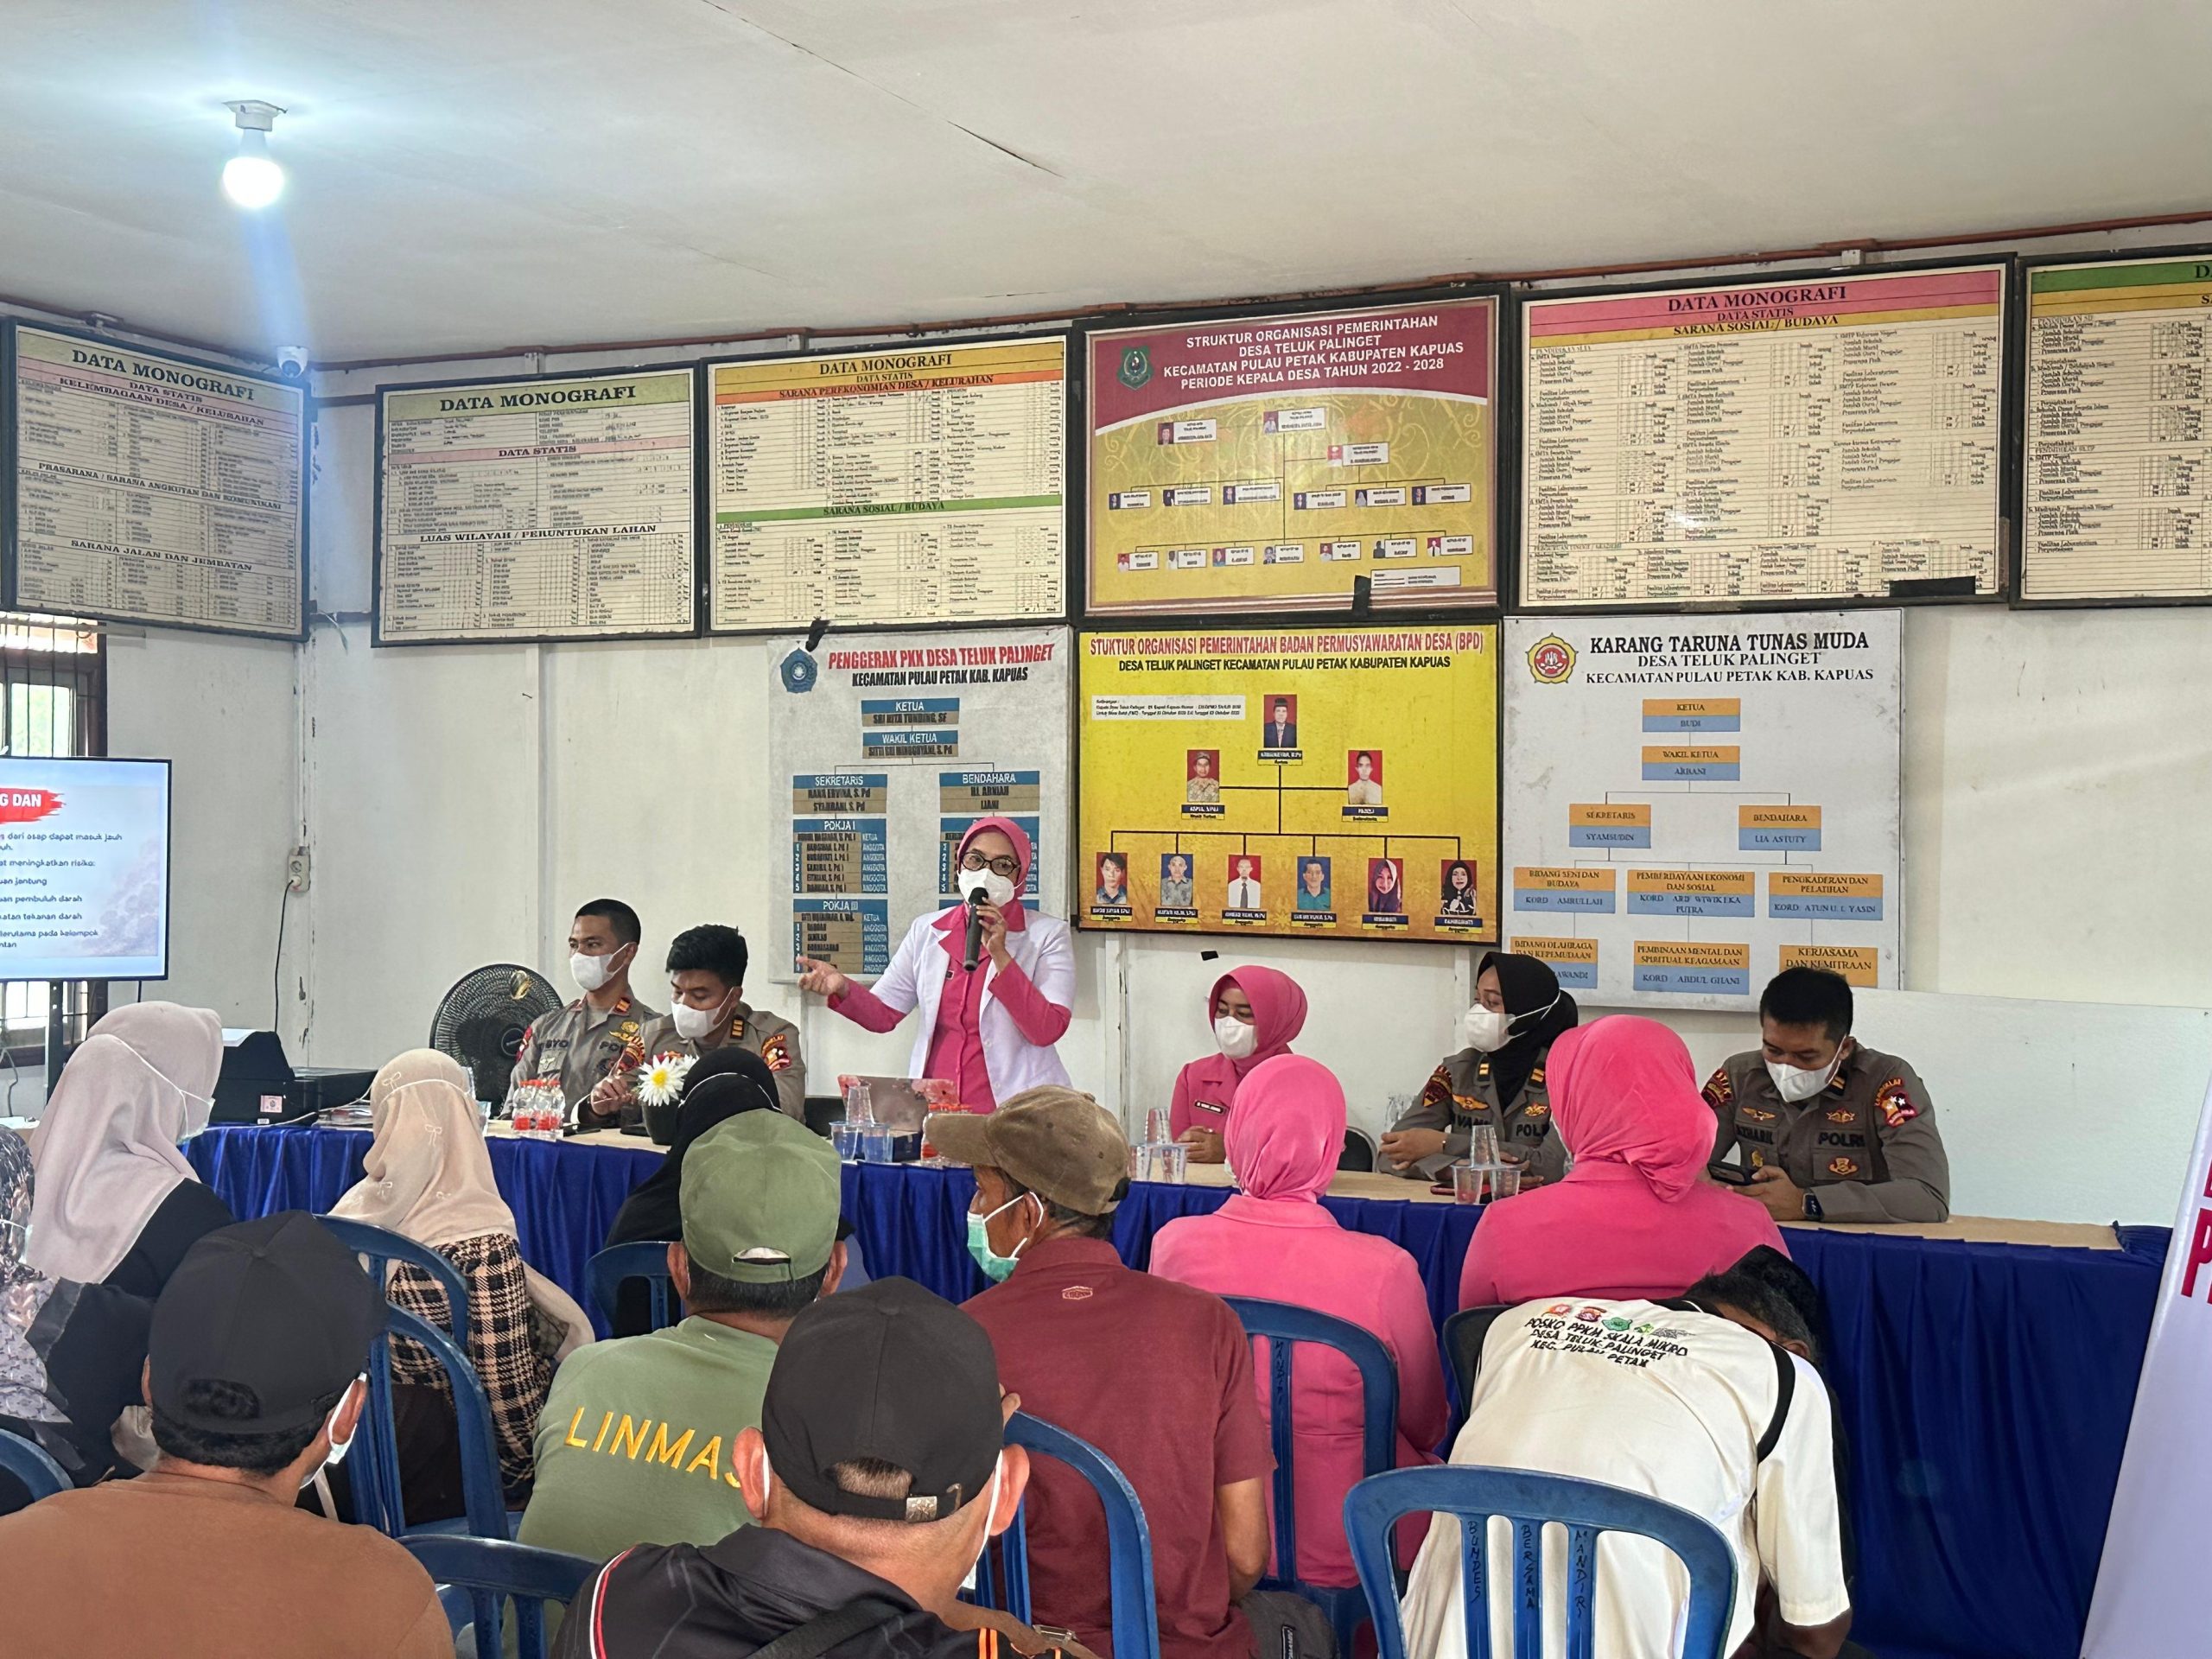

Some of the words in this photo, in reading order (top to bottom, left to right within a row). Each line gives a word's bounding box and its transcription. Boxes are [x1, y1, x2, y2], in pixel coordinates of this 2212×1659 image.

[1668, 296, 1717, 312] DATA
[1724, 286, 1847, 308] MONOGRAFI
[1717, 311, 1750, 321] DATA
[1751, 308, 1794, 320] STATIS
[1186, 332, 1252, 348] STRUKTUR
[1255, 326, 1332, 341] ORGANISASI
[1336, 315, 1438, 334] PEMERINTAHAN
[1674, 324, 1724, 335] SARANA
[1783, 315, 1839, 328] BUDAYA
[1239, 346, 1271, 358] DESA
[1274, 341, 1316, 354] TELUK
[1319, 334, 1382, 350] PALINGET
[820, 360, 857, 375] DATA
[861, 353, 952, 372] MONOGRAFI
[1164, 361, 1238, 378] KECAMATAN
[1241, 357, 1281, 371] PULAU
[1285, 353, 1325, 366] PETAK
[1330, 347, 1406, 363] KABUPATEN
[1409, 341, 1464, 357] KAPUAS
[72, 349, 127, 372] DATA
[132, 361, 255, 401] MONOGRAFI
[856, 374, 880, 383] DATA
[882, 372, 912, 381] STATIS
[1181, 375, 1233, 390] PERIODE
[1236, 371, 1284, 385] KEPALA
[1287, 367, 1320, 381] DESA
[1324, 363, 1368, 378] TAHUN
[1371, 361, 1402, 374] 2022
[1413, 358, 1444, 372] 2028
[60, 377, 153, 402] KELEMBAGAAN
[130, 382, 159, 394] DATA
[779, 388, 817, 398] SARANA
[819, 381, 895, 396] PEREKONOMIAN
[898, 379, 923, 390] DESA
[931, 374, 994, 388] KELURAHAN
[440, 397, 494, 411] DATA
[500, 385, 636, 408] MONOGRAFI
[499, 447, 531, 457] DATA
[533, 444, 576, 455] STATIS
[823, 504, 861, 517] SARANA
[862, 502, 896, 515] SOSIAL
[905, 501, 944, 512] BUDAYA
[420, 533, 451, 543] LUAS
[454, 531, 512, 542] WILAYAH
[522, 526, 608, 539] PERUNTUKAN
[612, 524, 657, 535] LAHAN
[71, 539, 119, 554] SARANA
[123, 546, 161, 559] JALAN
[1090, 638, 1135, 655] STUKTUR
[1138, 637, 1197, 655] ORGANISASI
[1199, 636, 1276, 654] PEMERINTAHAN
[1281, 636, 1313, 653] BADAN
[1318, 633, 1421, 652] PERMUSYAWARATAN
[1425, 633, 1452, 651] DESA
[1455, 632, 1483, 654] (BPD)
[1590, 636, 1663, 653] KARANG
[1669, 634, 1742, 652] TARUNA
[1747, 633, 1808, 651] TUNAS
[1813, 632, 1869, 650] MUDA
[829, 650, 898, 670] PENGGERAK
[900, 649, 924, 667] PKK
[926, 648, 957, 667] DESA
[960, 646, 995, 665] TELUK
[999, 644, 1055, 664] PALINGET
[1119, 660, 1143, 671] DESA
[1146, 660, 1174, 671] TELUK
[1177, 659, 1221, 671] PALINGET
[1224, 658, 1280, 671] KECAMATAN
[1282, 658, 1314, 670] PULAU
[1317, 658, 1348, 670] PETAK
[1351, 658, 1408, 669] KABUPATEN
[1410, 656, 1451, 668] KAPUAS
[1638, 654, 1678, 667] DESA
[1681, 653, 1736, 666] TELUK
[1739, 652, 1822, 665] PALINGET
[852, 671, 906, 687] KECAMATAN
[908, 671, 937, 685] PULAU
[939, 670, 968, 684] PETAK
[969, 669, 990, 683] KAB.
[993, 666, 1028, 683] KAPUAS
[1586, 671, 1674, 683] KECAMATAN
[1675, 671, 1723, 683] PULAU
[1726, 671, 1772, 683] PETAK
[1777, 670, 1811, 683] KAB.
[1814, 669, 1874, 681] KAPUAS
[895, 702, 924, 712] KETUA
[882, 734, 907, 744] WAKIL
[910, 733, 937, 744] KETUA
[1690, 750, 1719, 759] KETUA
[815, 776, 863, 786] SEKRETARIS
[962, 773, 1016, 784] BENDAHARA
[12, 793, 41, 807] DAN
[823, 821, 851, 830] POKJA
[15, 877, 48, 887] jantung
[1547, 880, 1580, 888] BUDAYA
[823, 900, 849, 911] POKJA
[1798, 947, 1859, 957] KERJASAMA
[1818, 1131, 1866, 1148] POLRI
[1525, 1318, 1566, 1329] POSKO
[1603, 1332, 1644, 1346] SKALA
[1645, 1339, 1688, 1357] MIKRO
[1607, 1353, 1649, 1368] PETAK
[1521, 1525, 1536, 1610] BERSAMA
